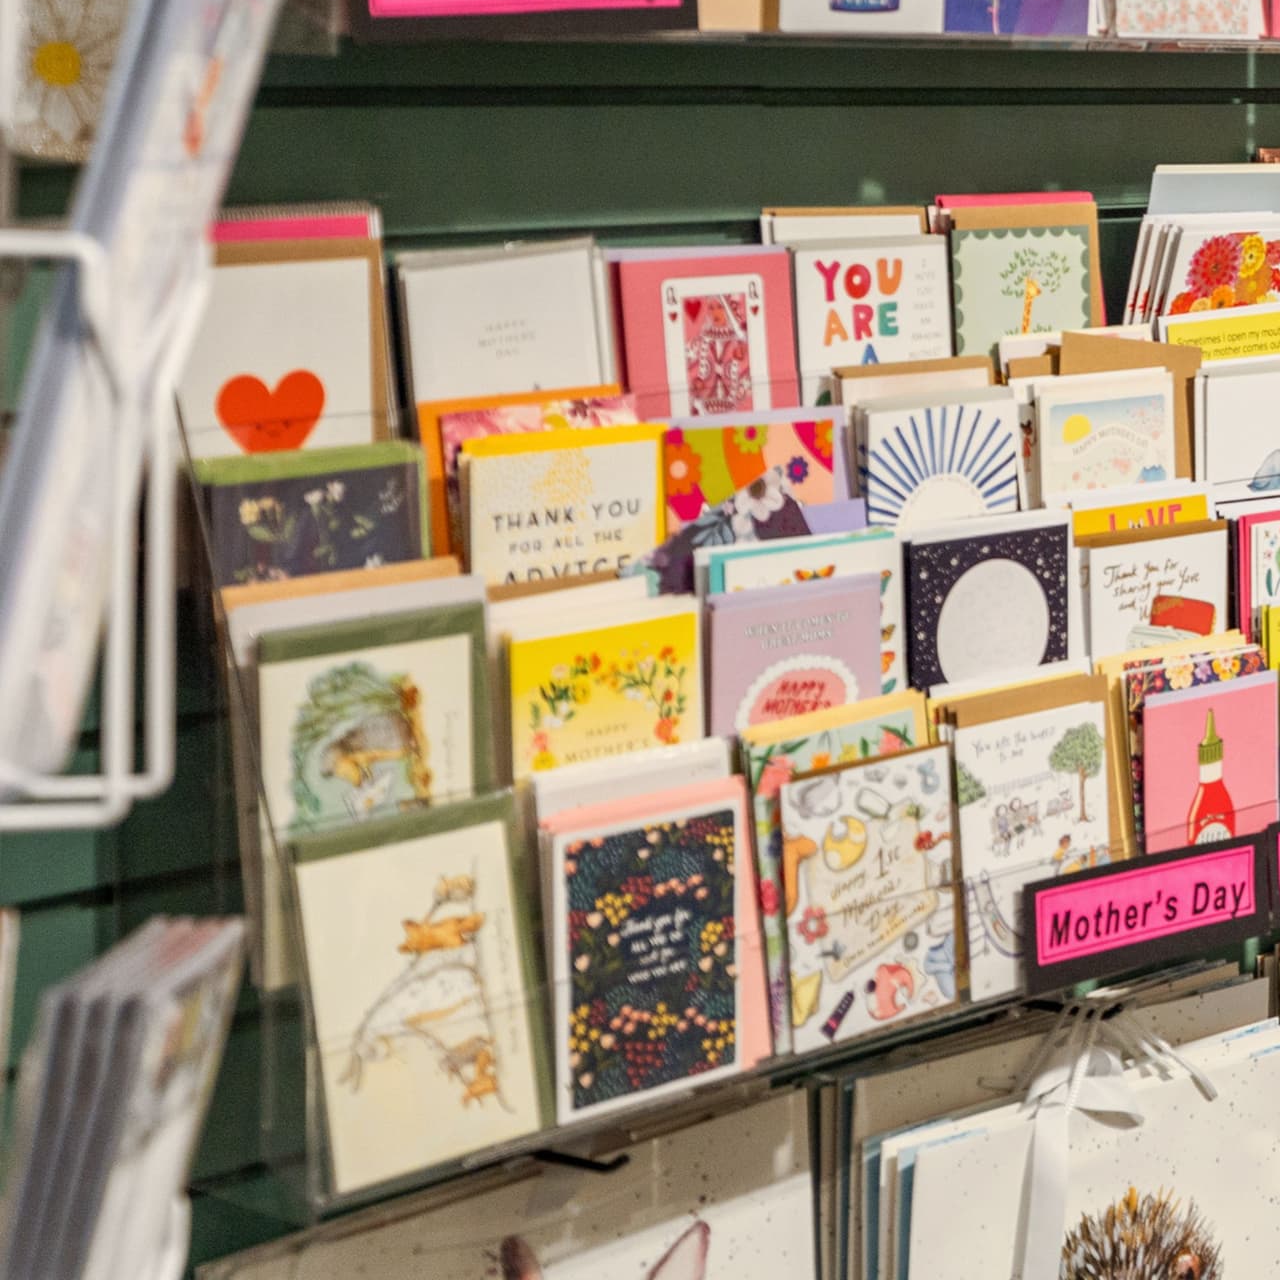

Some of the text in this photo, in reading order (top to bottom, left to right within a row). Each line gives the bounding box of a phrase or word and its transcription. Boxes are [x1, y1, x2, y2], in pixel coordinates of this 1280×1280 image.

[814, 258, 902, 301] YOU
[823, 302, 899, 346] ARE
[1178, 334, 1221, 346] Sometimes
[1227, 332, 1246, 345] open
[1250, 330, 1262, 341] my
[1213, 345, 1241, 356] mother
[1243, 343, 1268, 354] comes
[493, 498, 641, 533] THANK YOU
[508, 529, 624, 553] FOR ALL THE
[778, 681, 825, 695] HAPPY
[1050, 877, 1247, 949] Mother's Day
